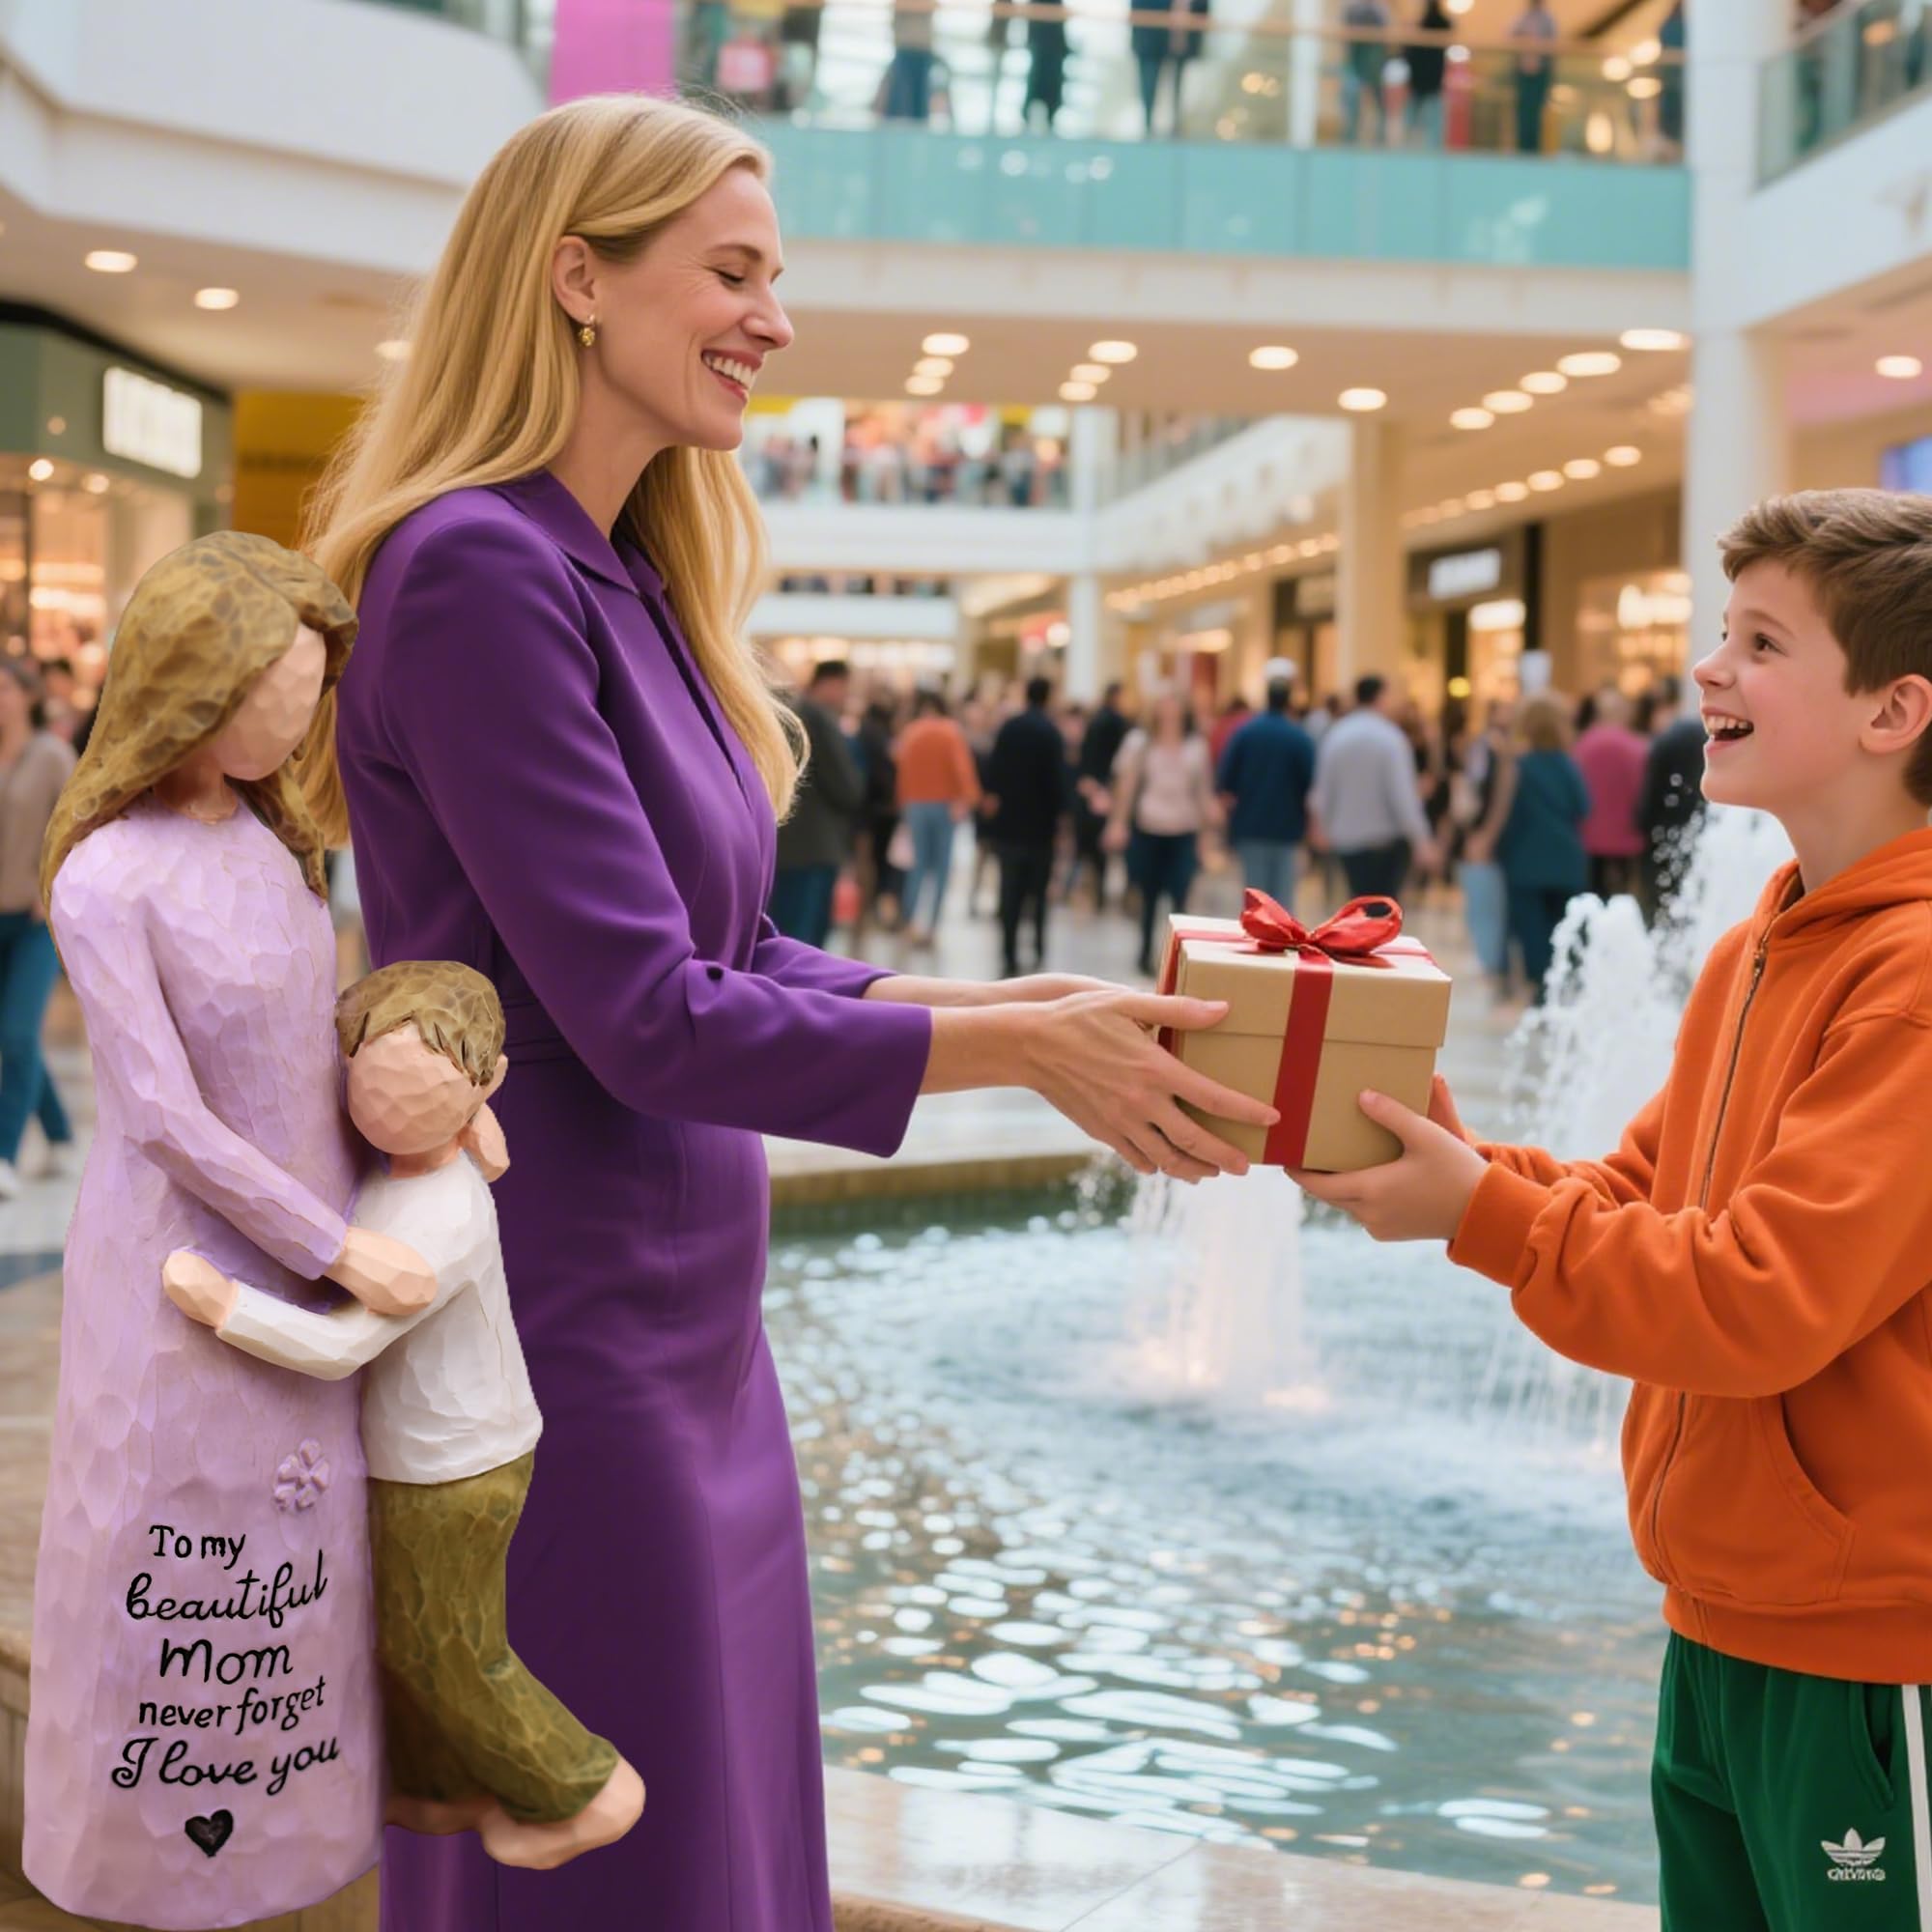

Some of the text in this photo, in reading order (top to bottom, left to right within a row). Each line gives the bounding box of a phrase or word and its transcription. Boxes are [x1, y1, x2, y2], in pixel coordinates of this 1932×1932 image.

[149, 1524, 246, 1571] To my
[126, 1548, 328, 1629] beautiful
[159, 1637, 294, 1685] Mom
[138, 1675, 327, 1736] never forget
[111, 1737, 340, 1797] I love you
